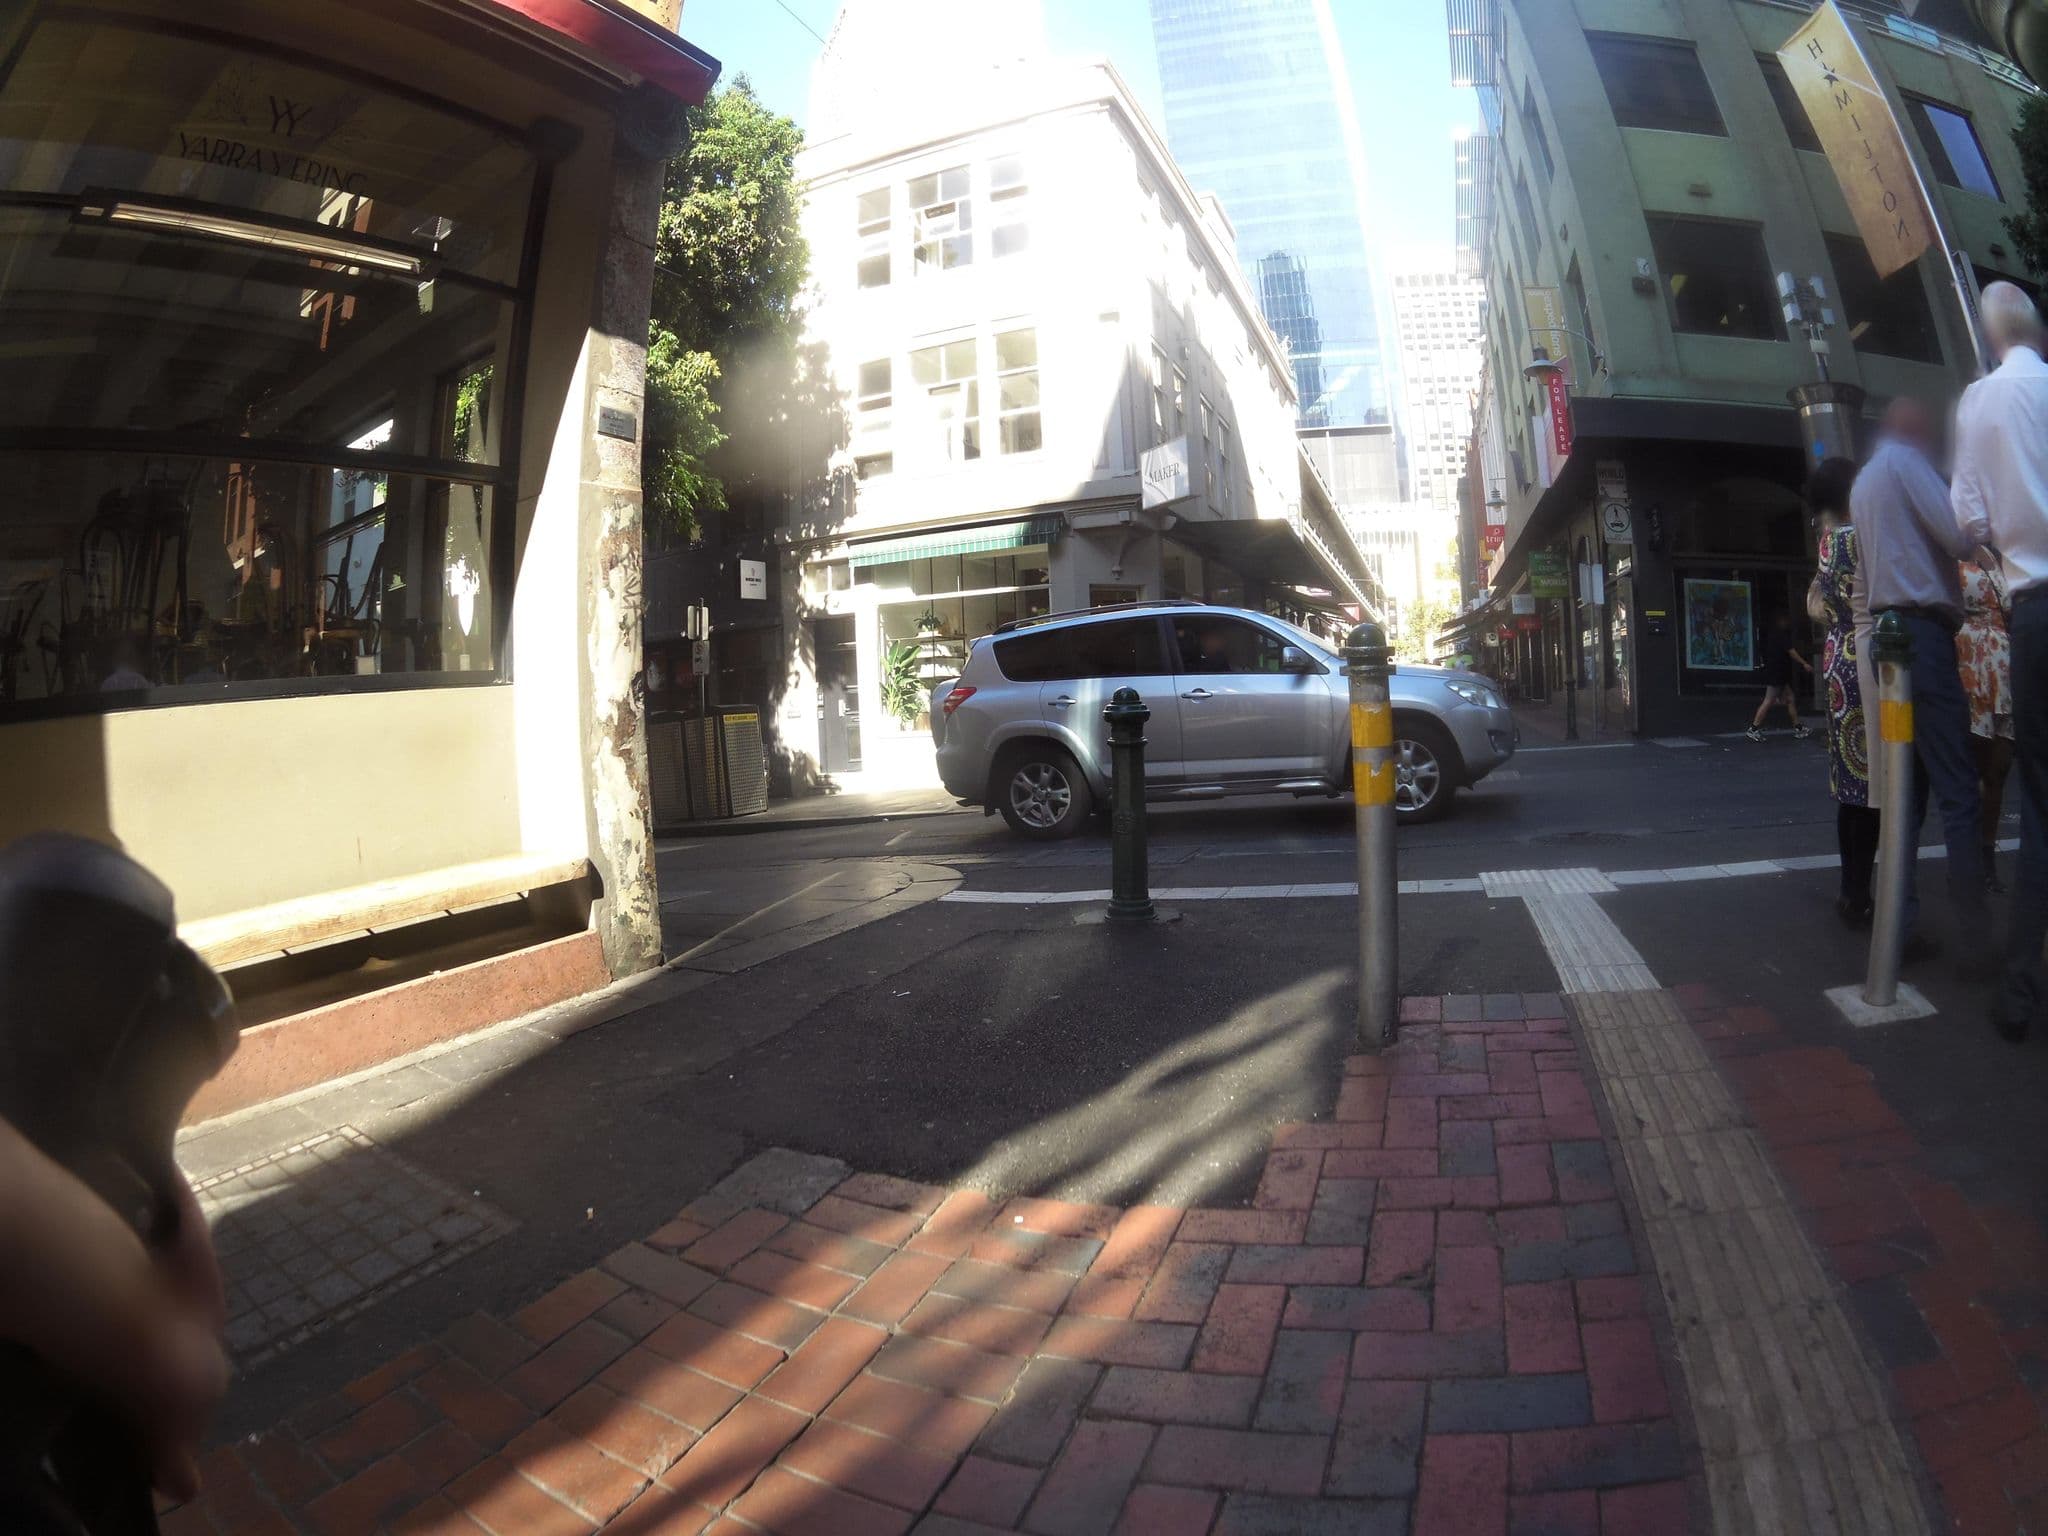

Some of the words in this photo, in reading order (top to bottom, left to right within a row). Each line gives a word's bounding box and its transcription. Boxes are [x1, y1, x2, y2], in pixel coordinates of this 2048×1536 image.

[180, 131, 263, 173] YARRA
[272, 151, 368, 192] YERING
[1552, 378, 1561, 402] FOR
[1556, 408, 1567, 451] LEASE
[1149, 462, 1180, 483] MAKER
